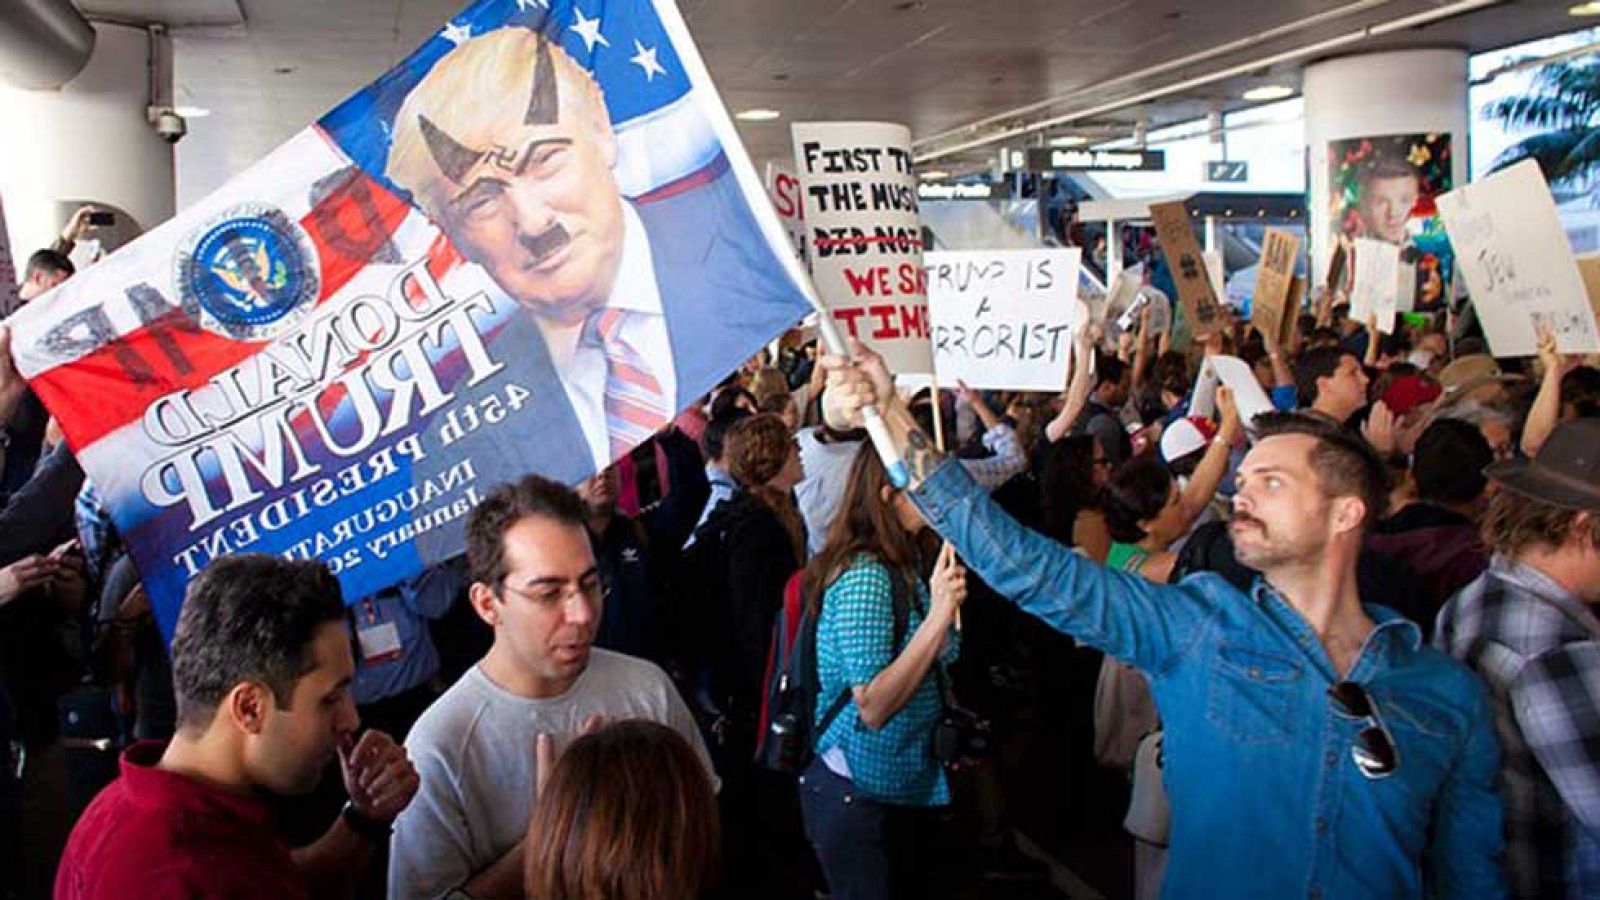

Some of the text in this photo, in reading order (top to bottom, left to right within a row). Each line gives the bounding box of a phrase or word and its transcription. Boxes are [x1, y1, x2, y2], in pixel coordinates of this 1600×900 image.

[803, 141, 881, 174] FIRST
[808, 182, 868, 213] THE
[814, 226, 868, 257] DID
[844, 266, 890, 296] WE
[1026, 259, 1053, 290] IS
[931, 323, 1068, 363] RRORIST
